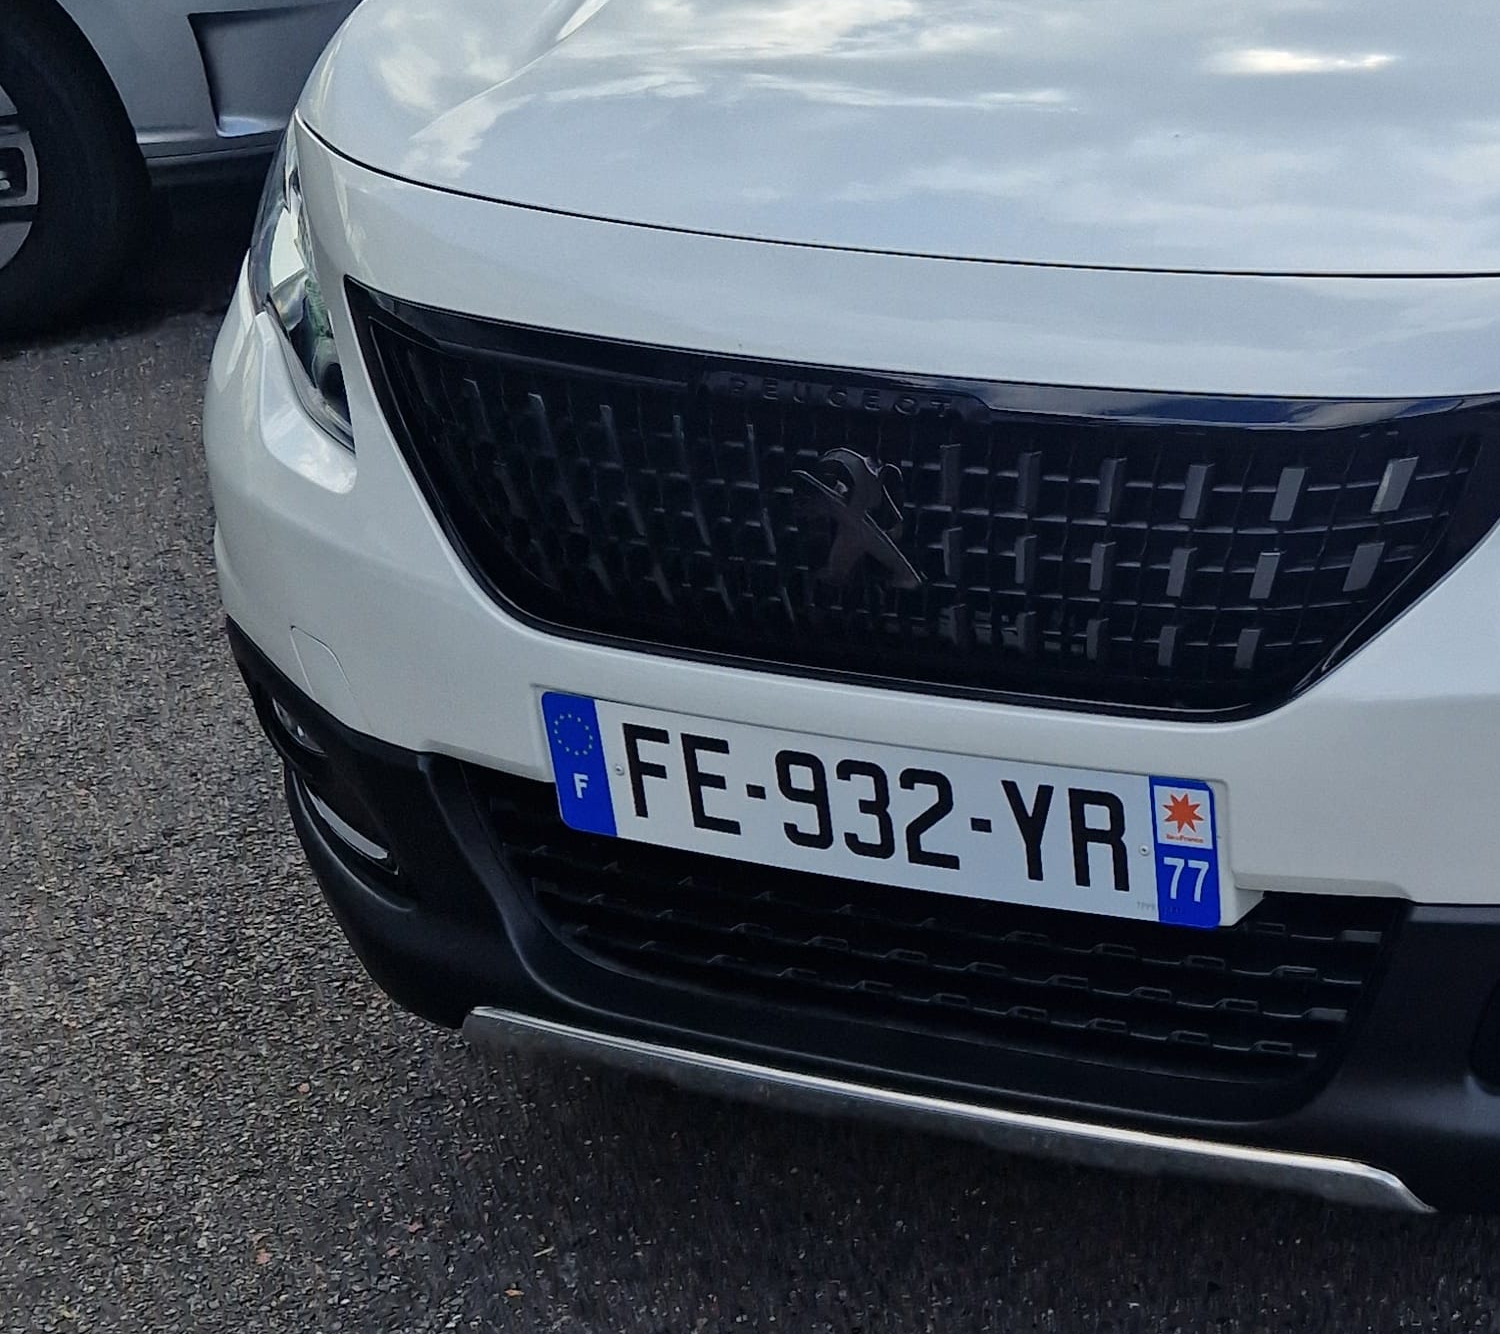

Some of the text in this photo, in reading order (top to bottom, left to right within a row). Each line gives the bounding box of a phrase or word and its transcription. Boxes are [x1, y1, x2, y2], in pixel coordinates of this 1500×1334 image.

[571, 773, 588, 800] F
[622, 723, 1130, 892] FE-932-YR
[1163, 856, 1209, 903] 77
